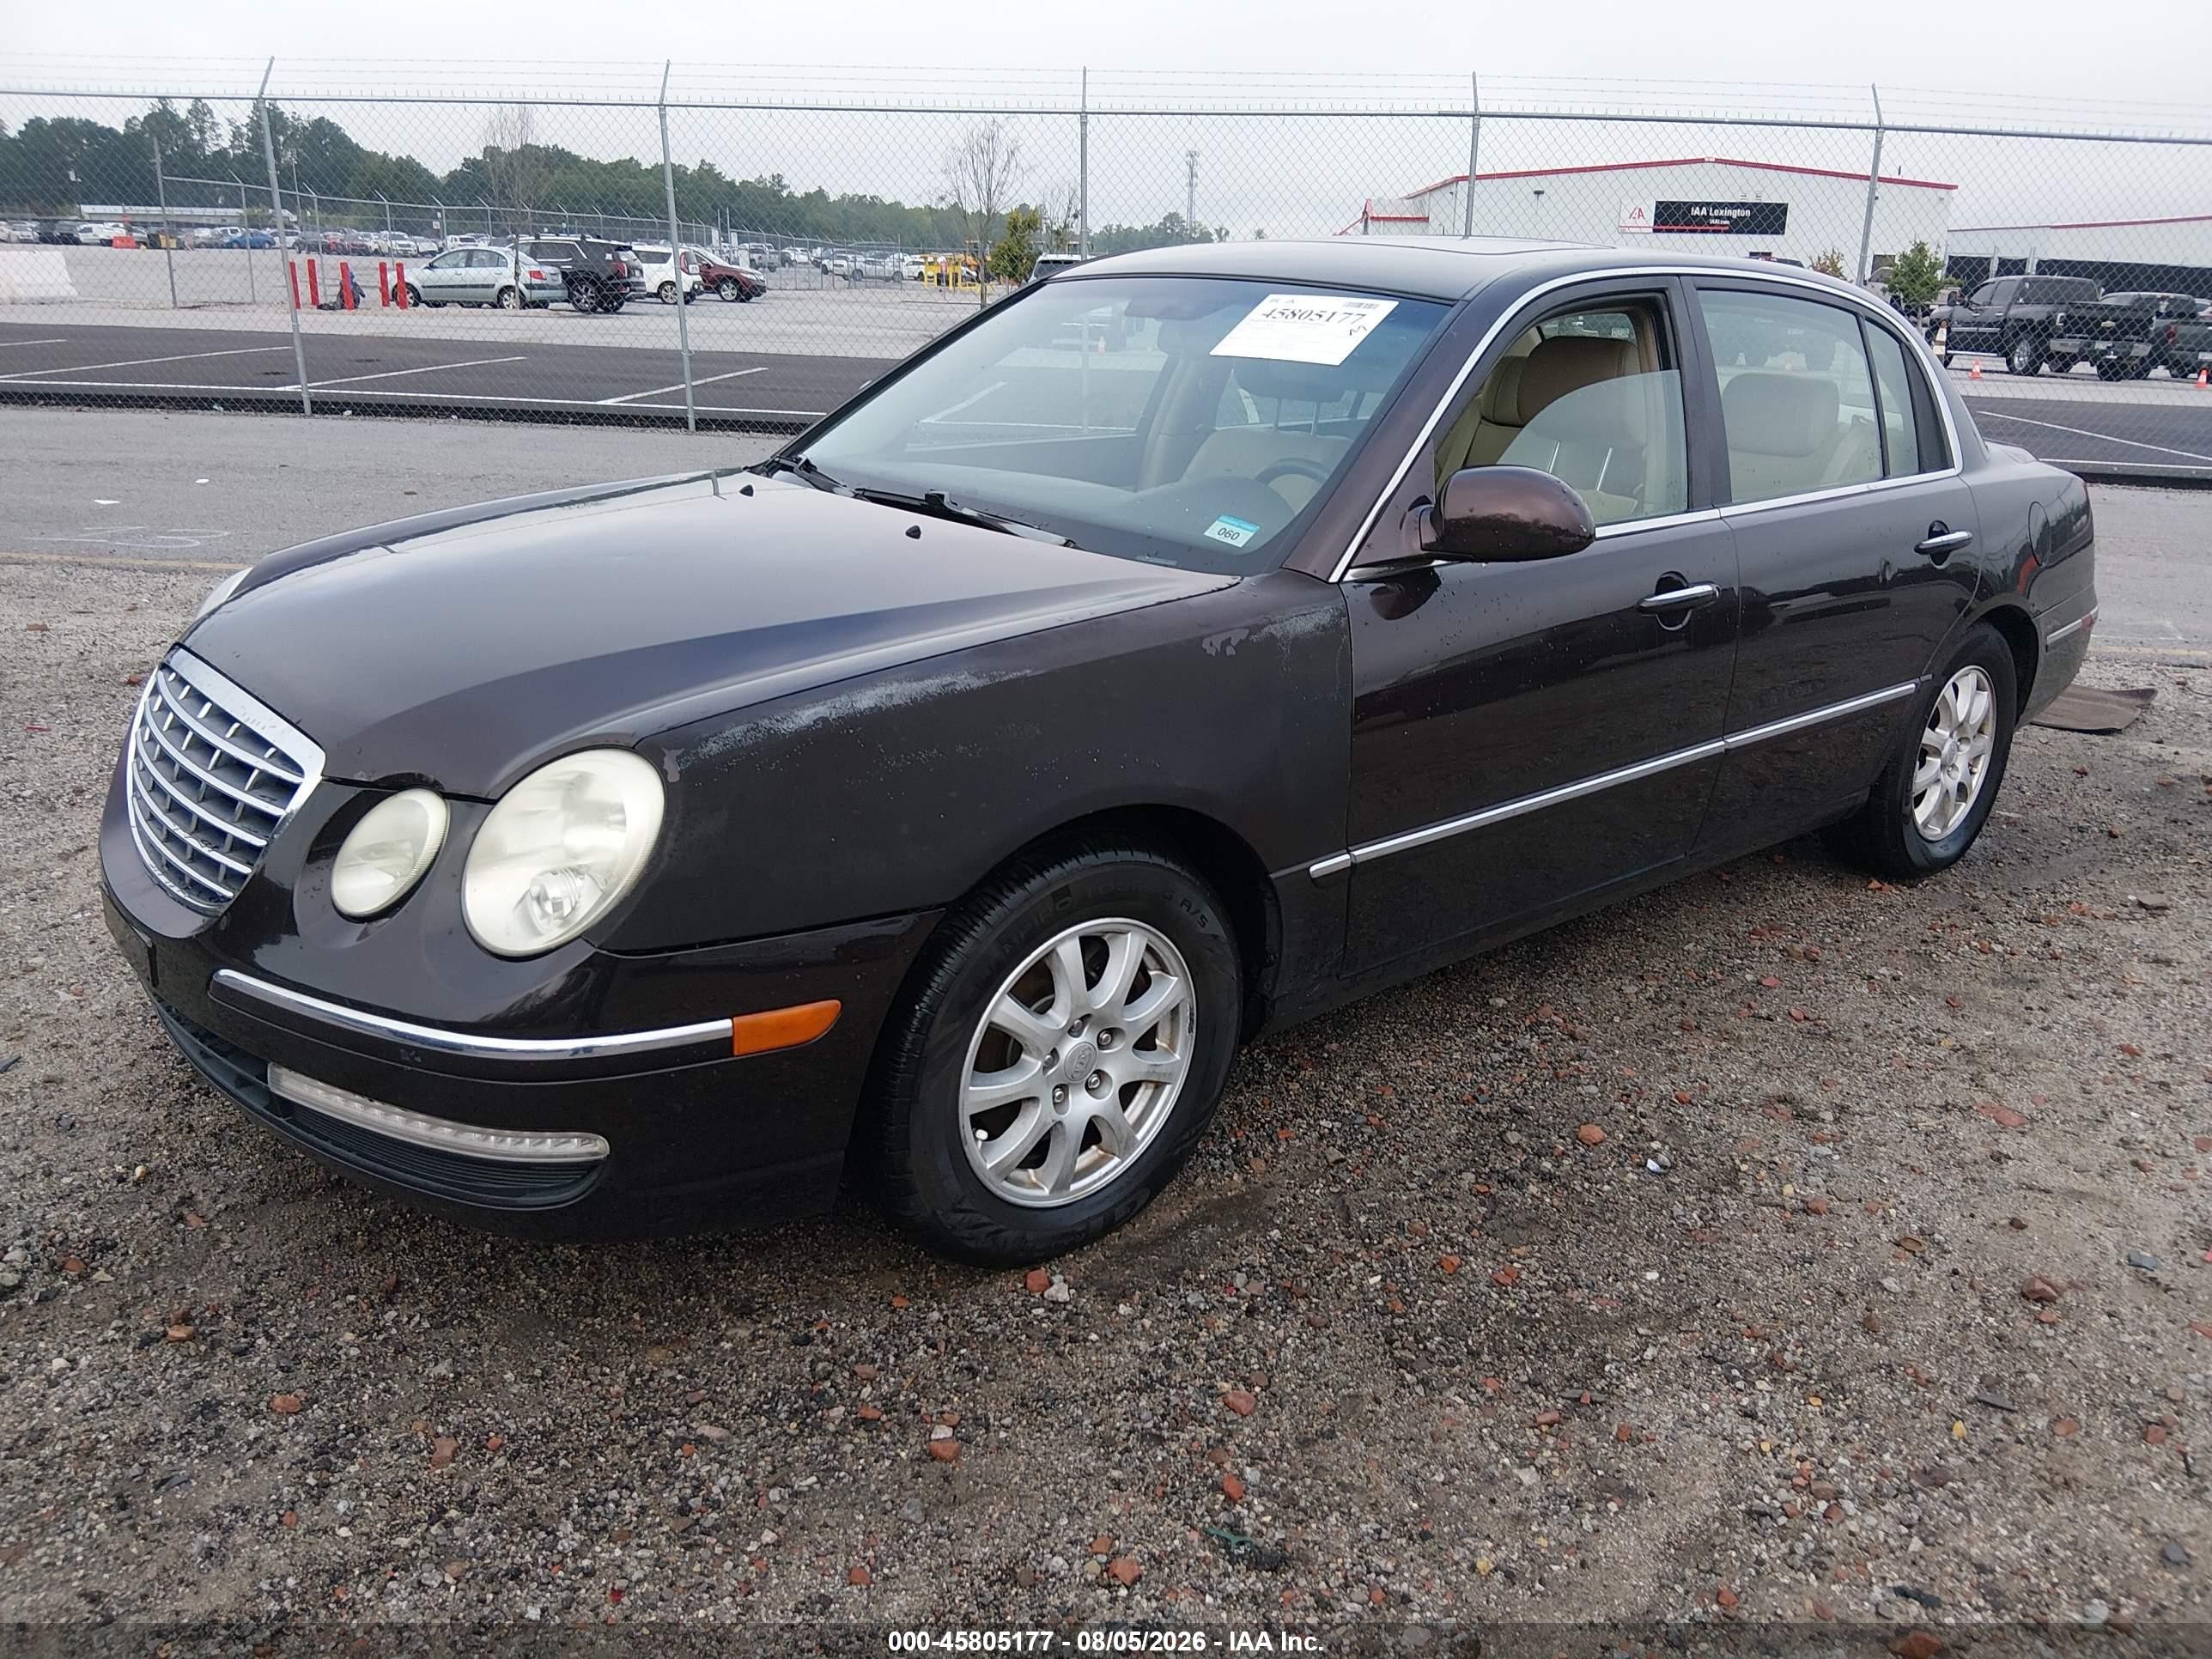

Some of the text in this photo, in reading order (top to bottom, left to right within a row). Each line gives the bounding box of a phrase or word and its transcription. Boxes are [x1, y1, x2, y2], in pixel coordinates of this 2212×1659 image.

[1691, 206, 1751, 218] IAA Lexington
[1261, 307, 1367, 325] 45805177
[1217, 527, 1240, 540] 060
